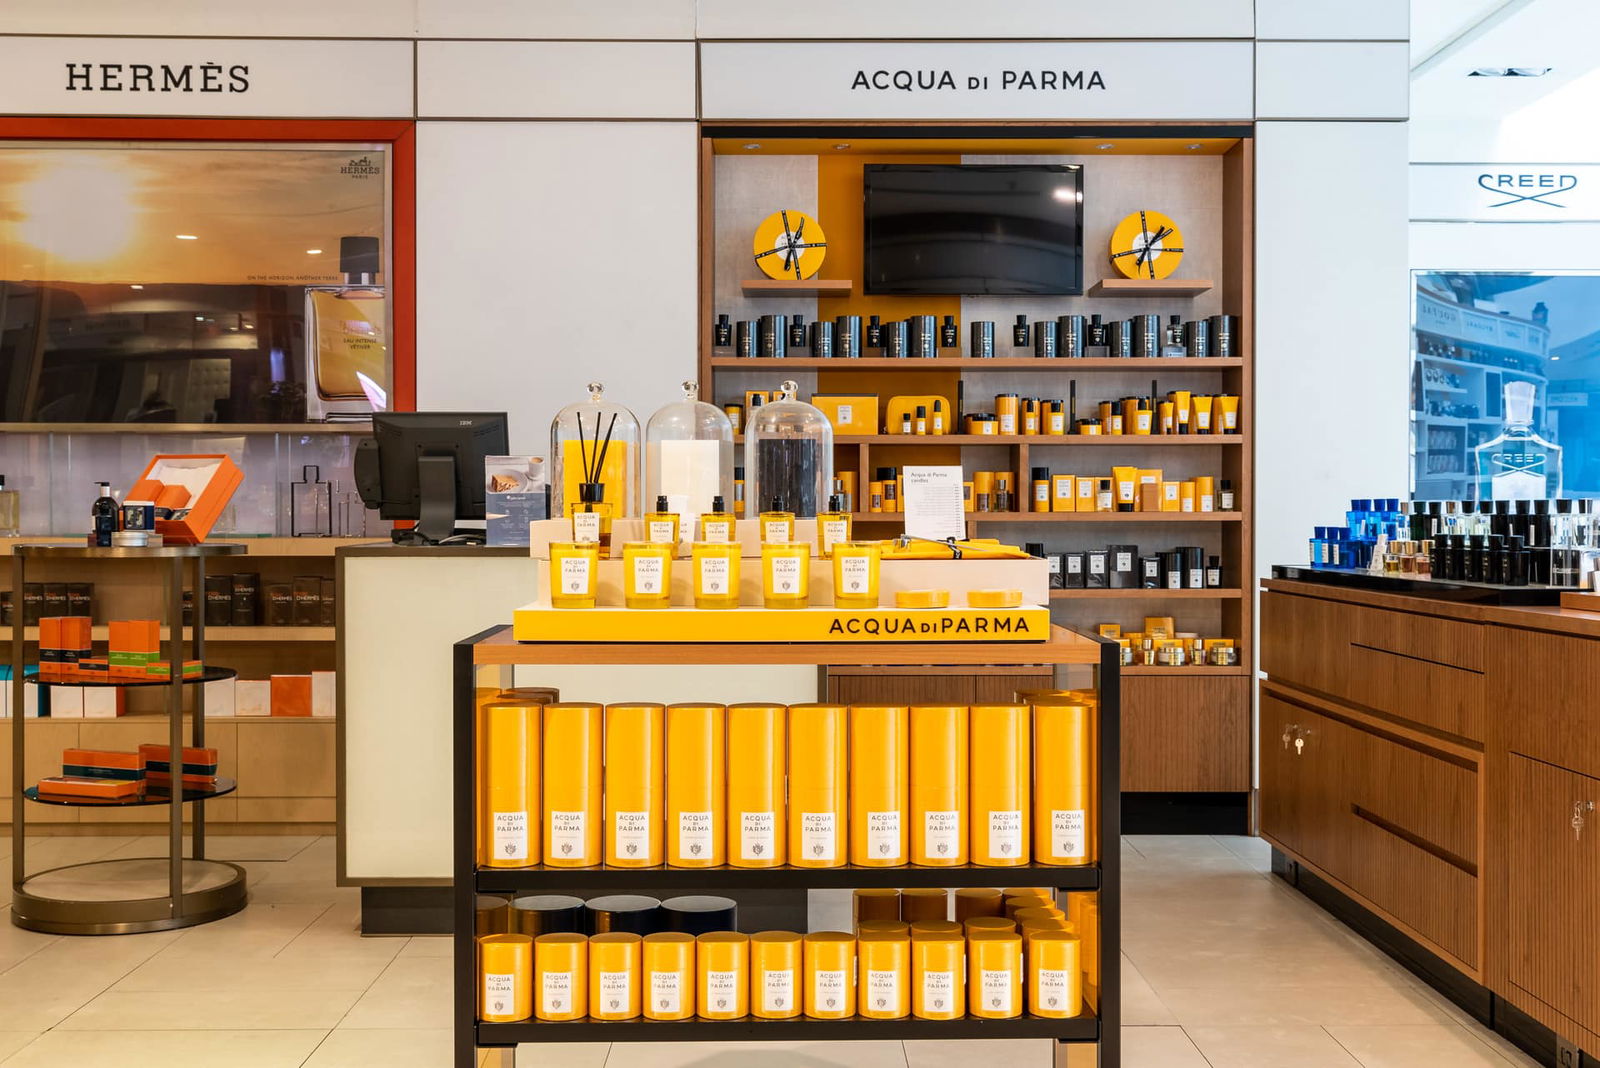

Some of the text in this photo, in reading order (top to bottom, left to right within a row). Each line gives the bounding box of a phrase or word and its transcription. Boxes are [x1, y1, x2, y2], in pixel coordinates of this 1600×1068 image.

[66, 62, 249, 92] HERMÈS
[851, 70, 1106, 92] ACQUA DI PARMA
[829, 618, 1029, 634] ACQUA DI PARMA
